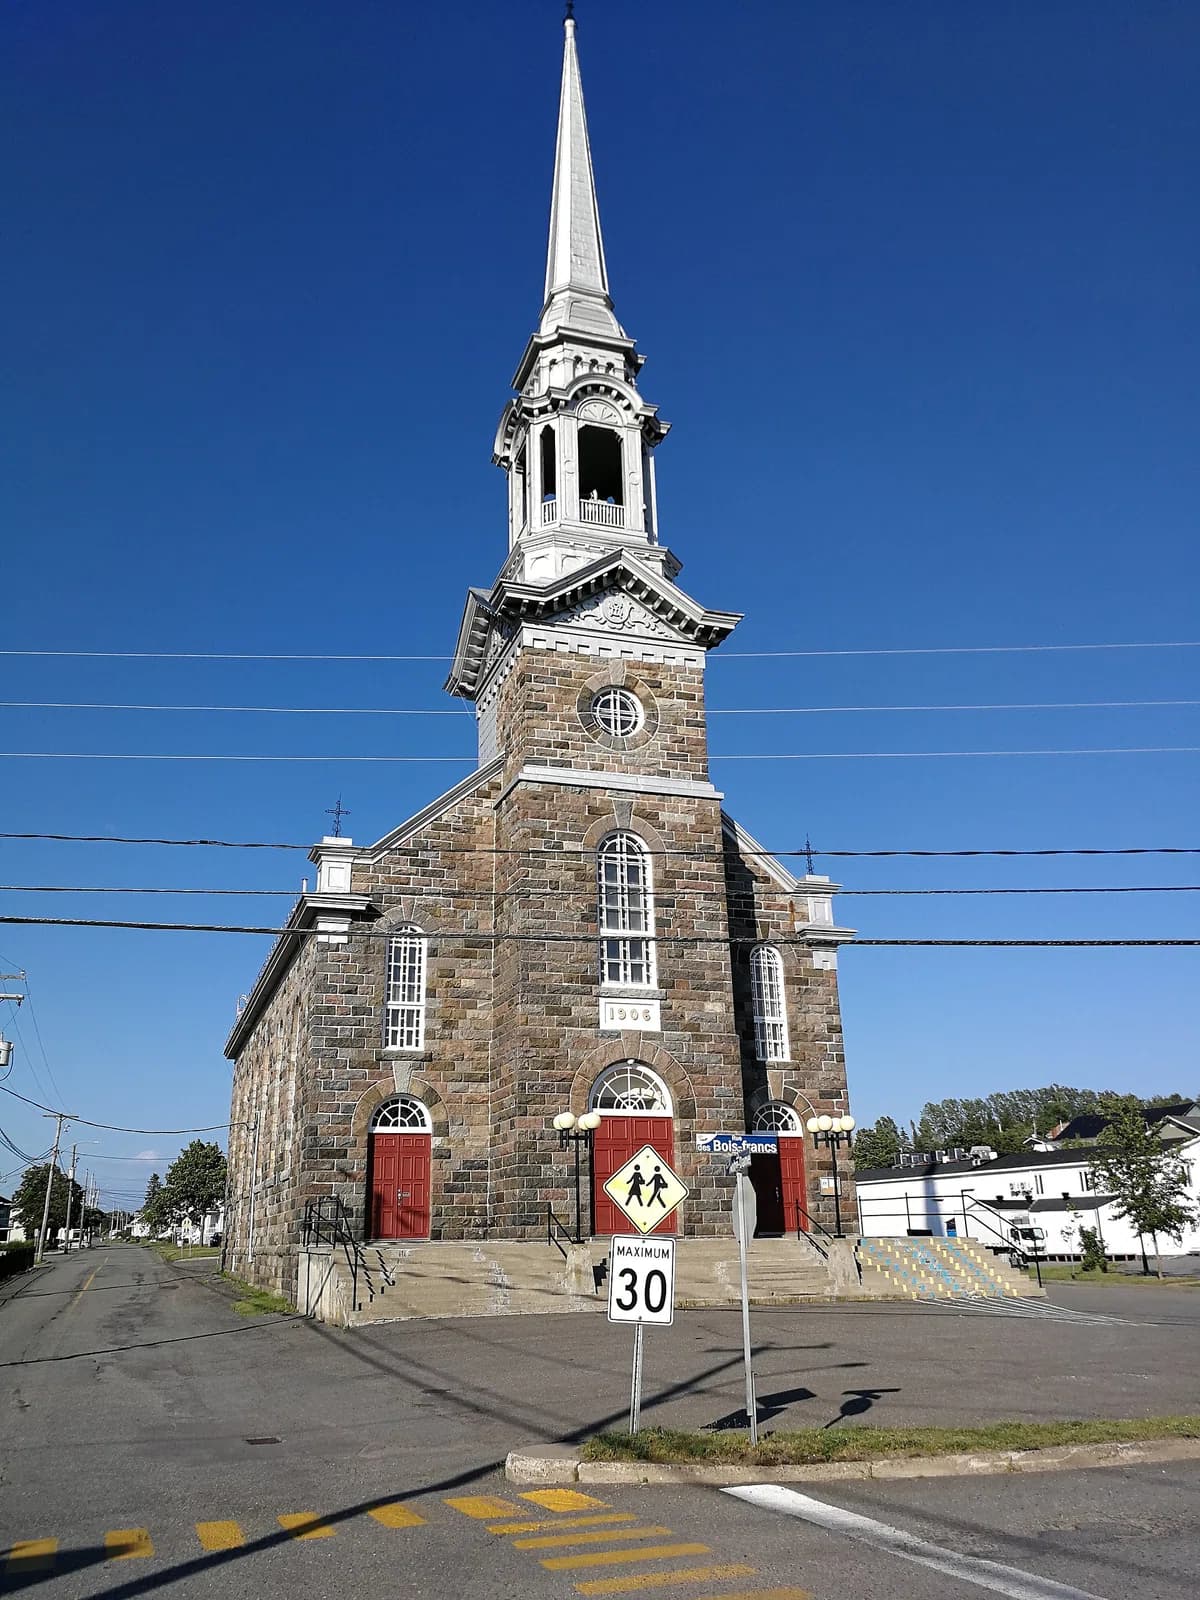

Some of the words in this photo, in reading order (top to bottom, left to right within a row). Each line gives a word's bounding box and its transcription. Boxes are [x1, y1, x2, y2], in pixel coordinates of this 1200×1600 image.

[609, 1007, 651, 1021] 1906
[697, 1144, 711, 1152] des
[713, 1140, 777, 1153] Bois-francs
[616, 1245, 670, 1260] MAXIMUM
[616, 1267, 667, 1314] 30
